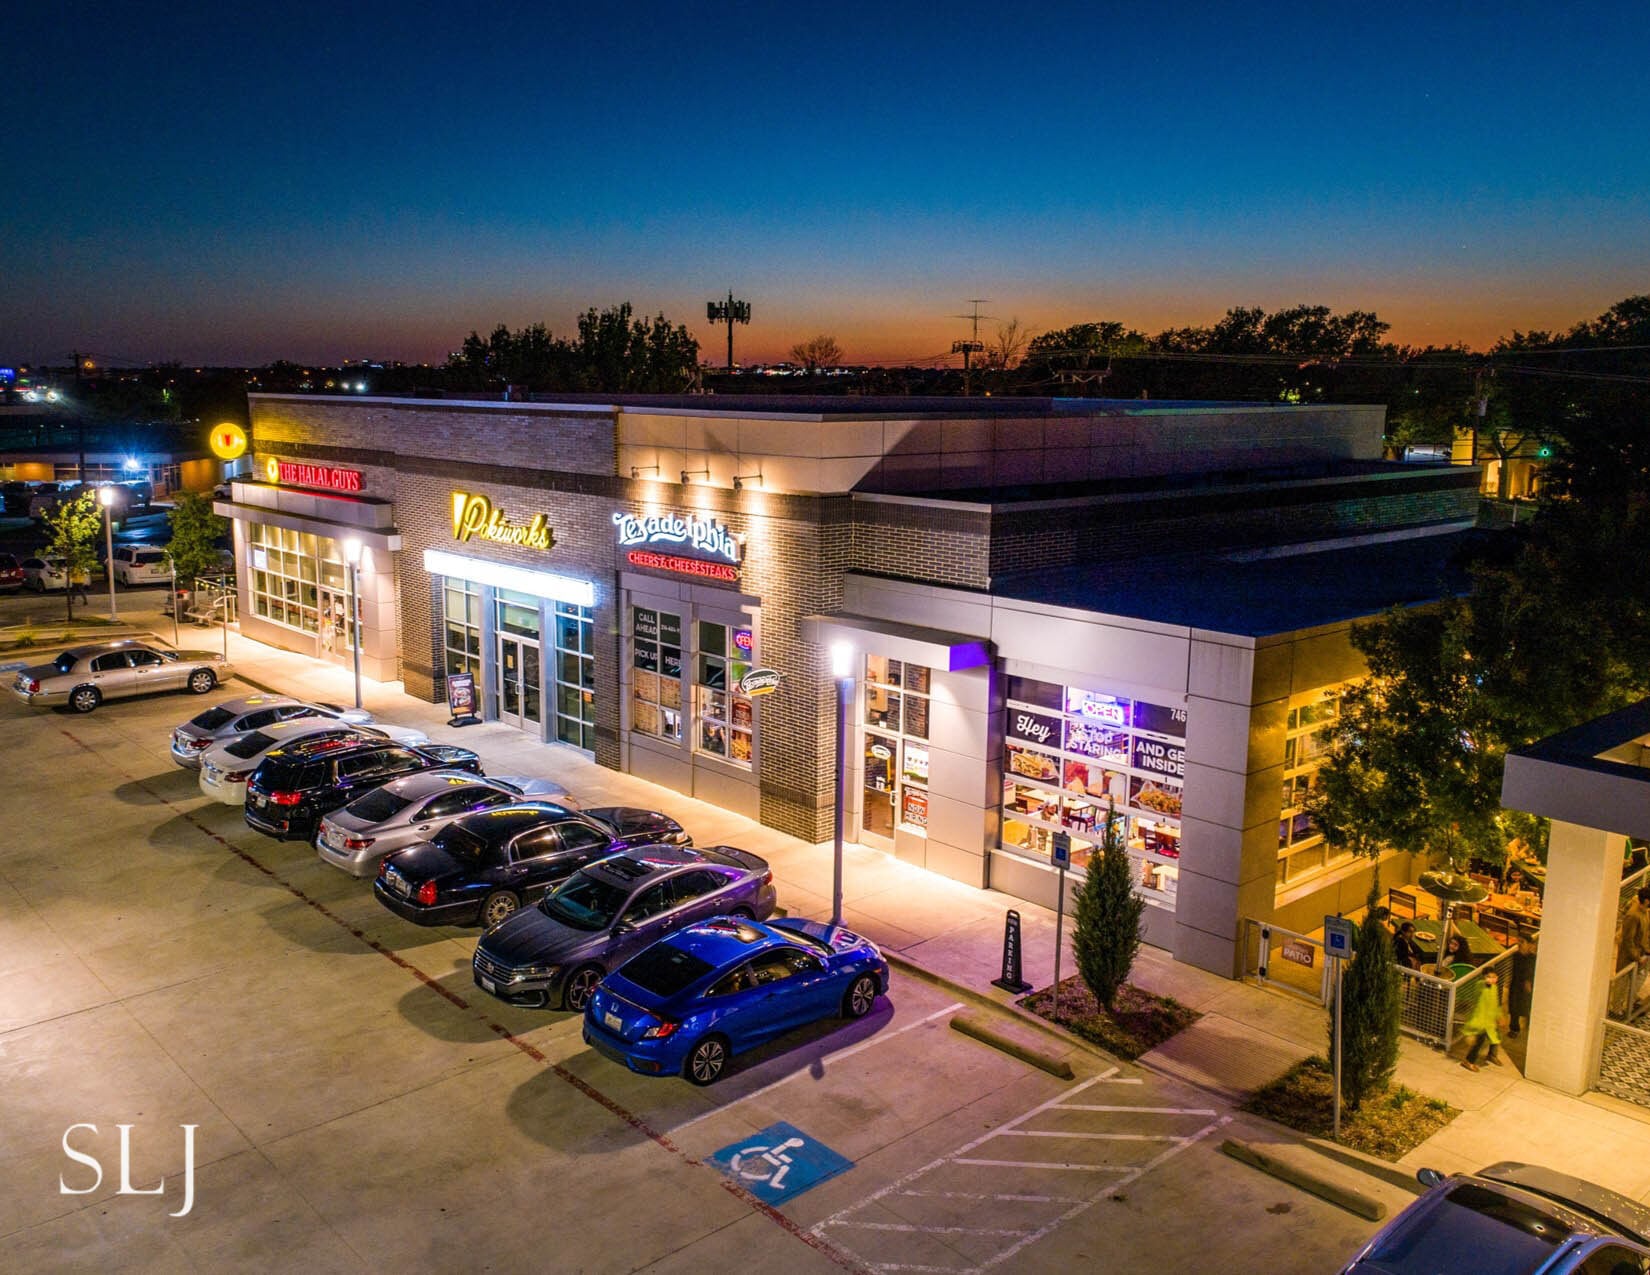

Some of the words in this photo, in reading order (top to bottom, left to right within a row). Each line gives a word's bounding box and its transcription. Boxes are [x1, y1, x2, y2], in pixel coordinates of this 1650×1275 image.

[279, 462, 298, 482] THE
[298, 464, 330, 487] HALAL
[331, 467, 360, 491] GUYS
[612, 512, 741, 562] Texadelphia
[628, 552, 660, 568] CHEERS
[668, 558, 735, 580] CHEESESTEAKS
[638, 612, 655, 623] CALL
[635, 623, 657, 634] AHEAD
[634, 648, 650, 660] PICK
[1083, 702, 1120, 722] OPEN
[1170, 708, 1186, 722] 746
[1016, 714, 1051, 743] Hey
[1071, 740, 1121, 760] STARING
[1135, 741, 1165, 757] AND
[1142, 755, 1185, 776] INSIDE
[908, 803, 925, 814] NOW
[1006, 926, 1015, 979] PARKING
[1283, 947, 1312, 964] PATIO
